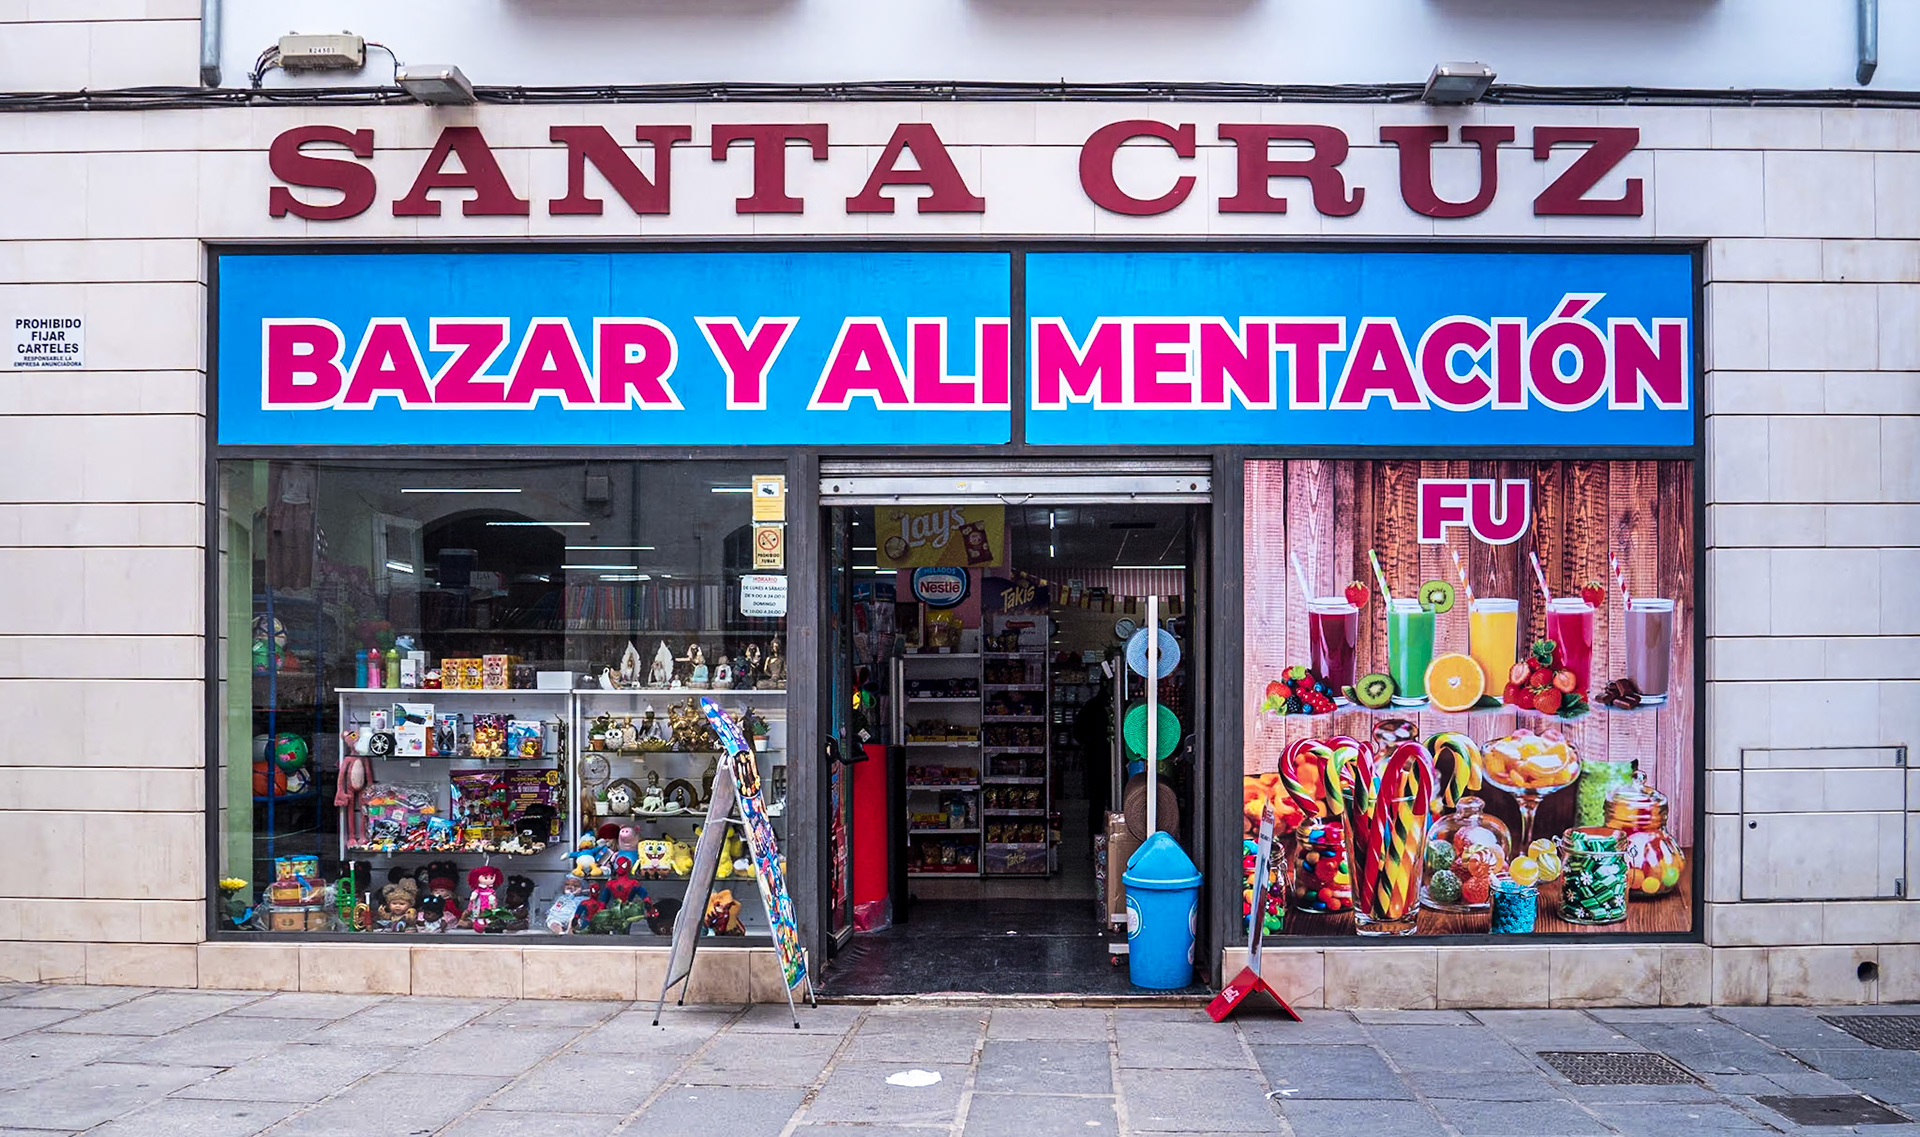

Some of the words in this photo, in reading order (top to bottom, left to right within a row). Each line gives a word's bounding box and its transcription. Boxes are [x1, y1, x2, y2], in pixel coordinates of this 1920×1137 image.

[269, 123, 986, 221] SANTA
[1079, 119, 1644, 219] CRUZ
[15, 318, 82, 329] PROHIBIDO
[31, 331, 65, 341] FIJAR
[17, 343, 79, 353] CARTELES
[261, 316, 685, 411] BAZAR
[694, 316, 800, 411] Y
[806, 292, 1689, 412] ALIMENTACIÓN
[1417, 478, 1530, 545] FU
[1000, 585, 1036, 614] Takis
